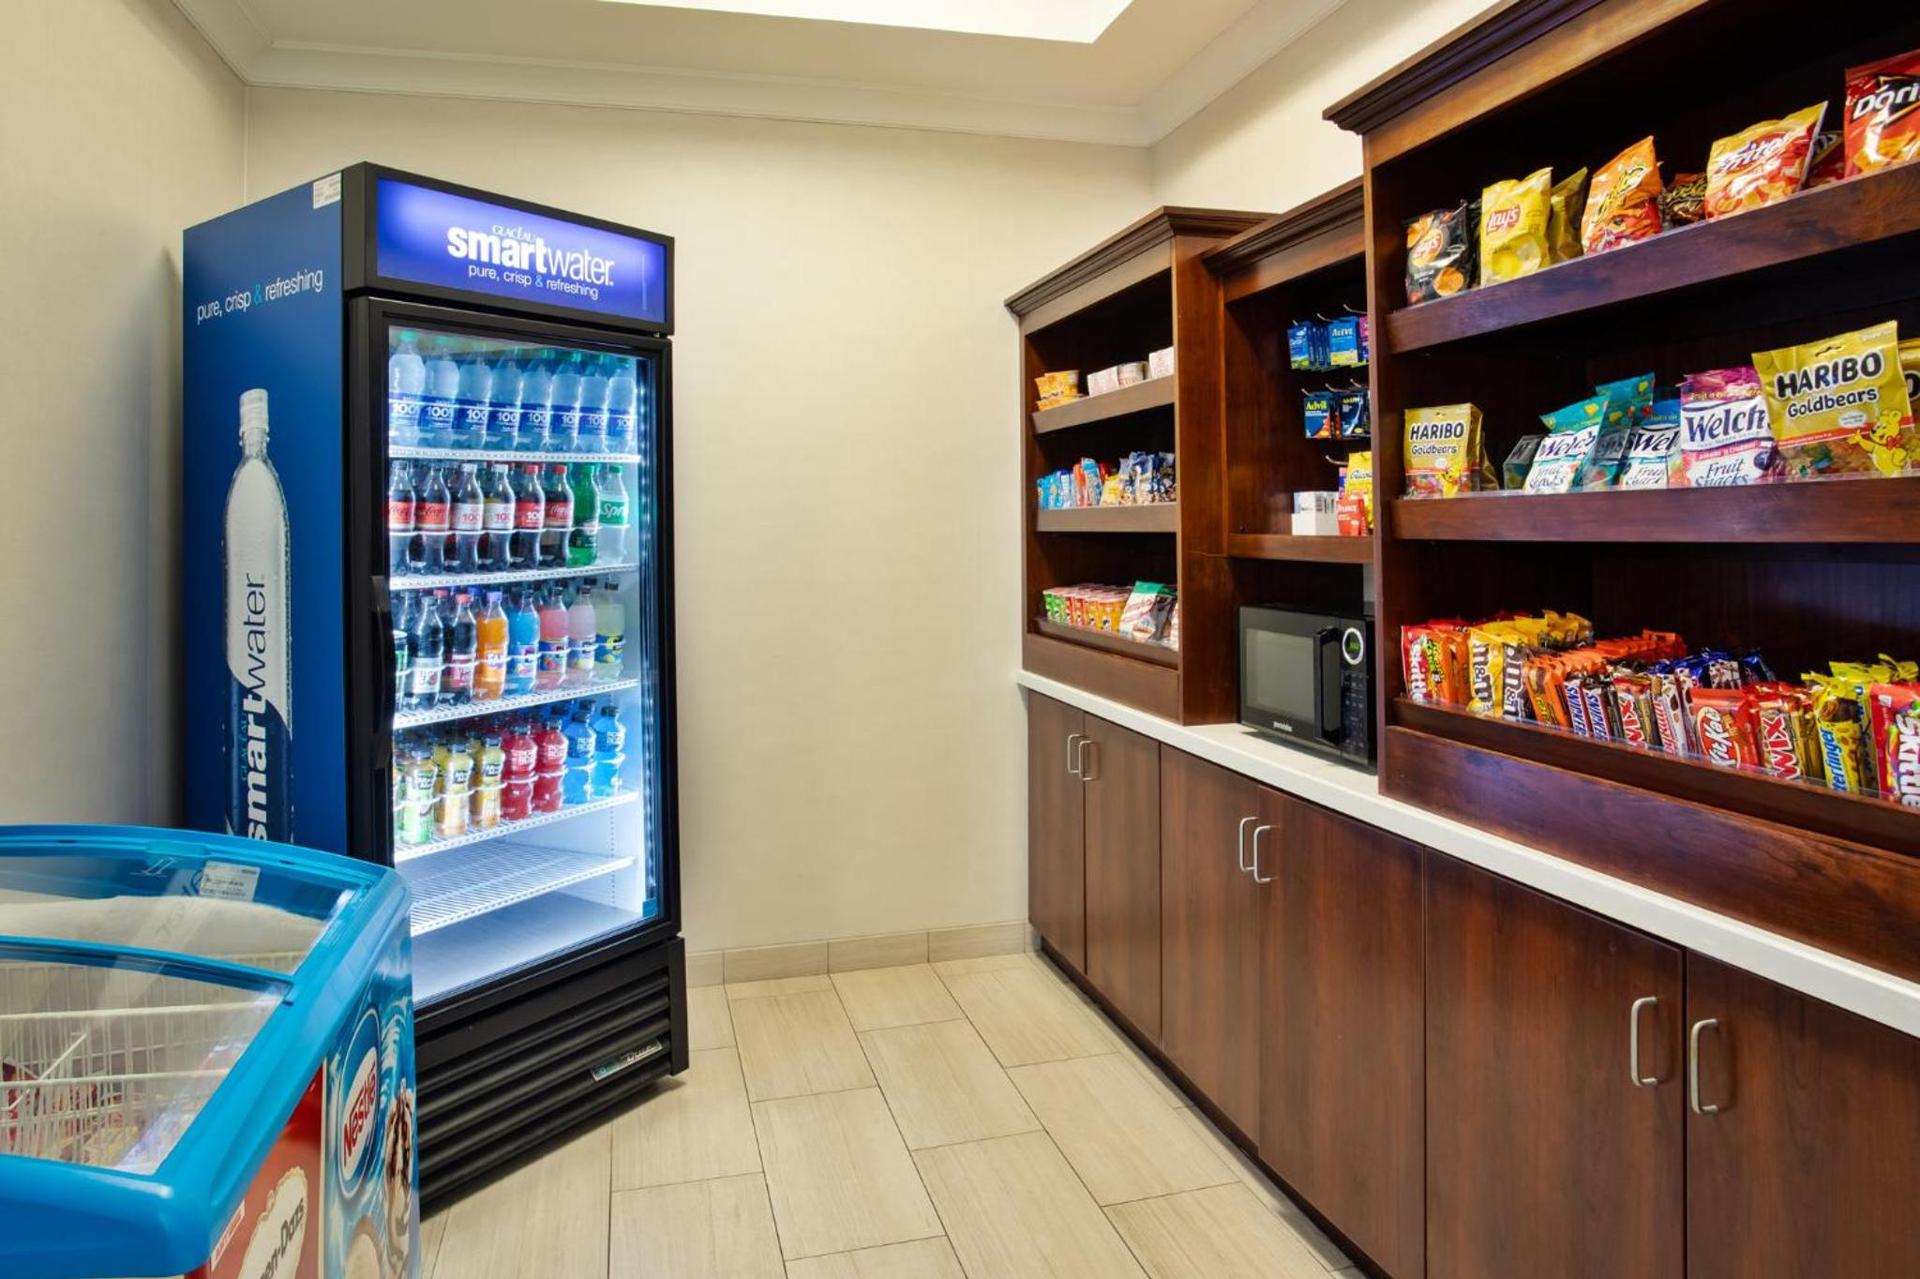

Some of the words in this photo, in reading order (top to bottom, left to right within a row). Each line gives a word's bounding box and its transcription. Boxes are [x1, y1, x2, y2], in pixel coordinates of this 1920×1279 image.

[1853, 83, 1920, 120] Dori
[196, 300, 223, 325] pure,
[224, 290, 251, 312] crisp
[254, 284, 262, 305] &
[265, 269, 323, 301] refreshing
[468, 265, 500, 281] pure,
[503, 270, 533, 287] crisp
[535, 275, 544, 287] &
[546, 279, 600, 301] refreshing
[1776, 352, 1883, 399] HARIBO
[1788, 388, 1878, 418] Goldbears
[1410, 422, 1465, 441] HARIBO
[1632, 429, 1680, 452] Wel
[1684, 404, 1771, 443] Welch
[1411, 444, 1457, 455] Goldbears
[1706, 459, 1745, 479] Fruit
[243, 573, 267, 841] smartwater
[1761, 714, 1800, 780] WIX
